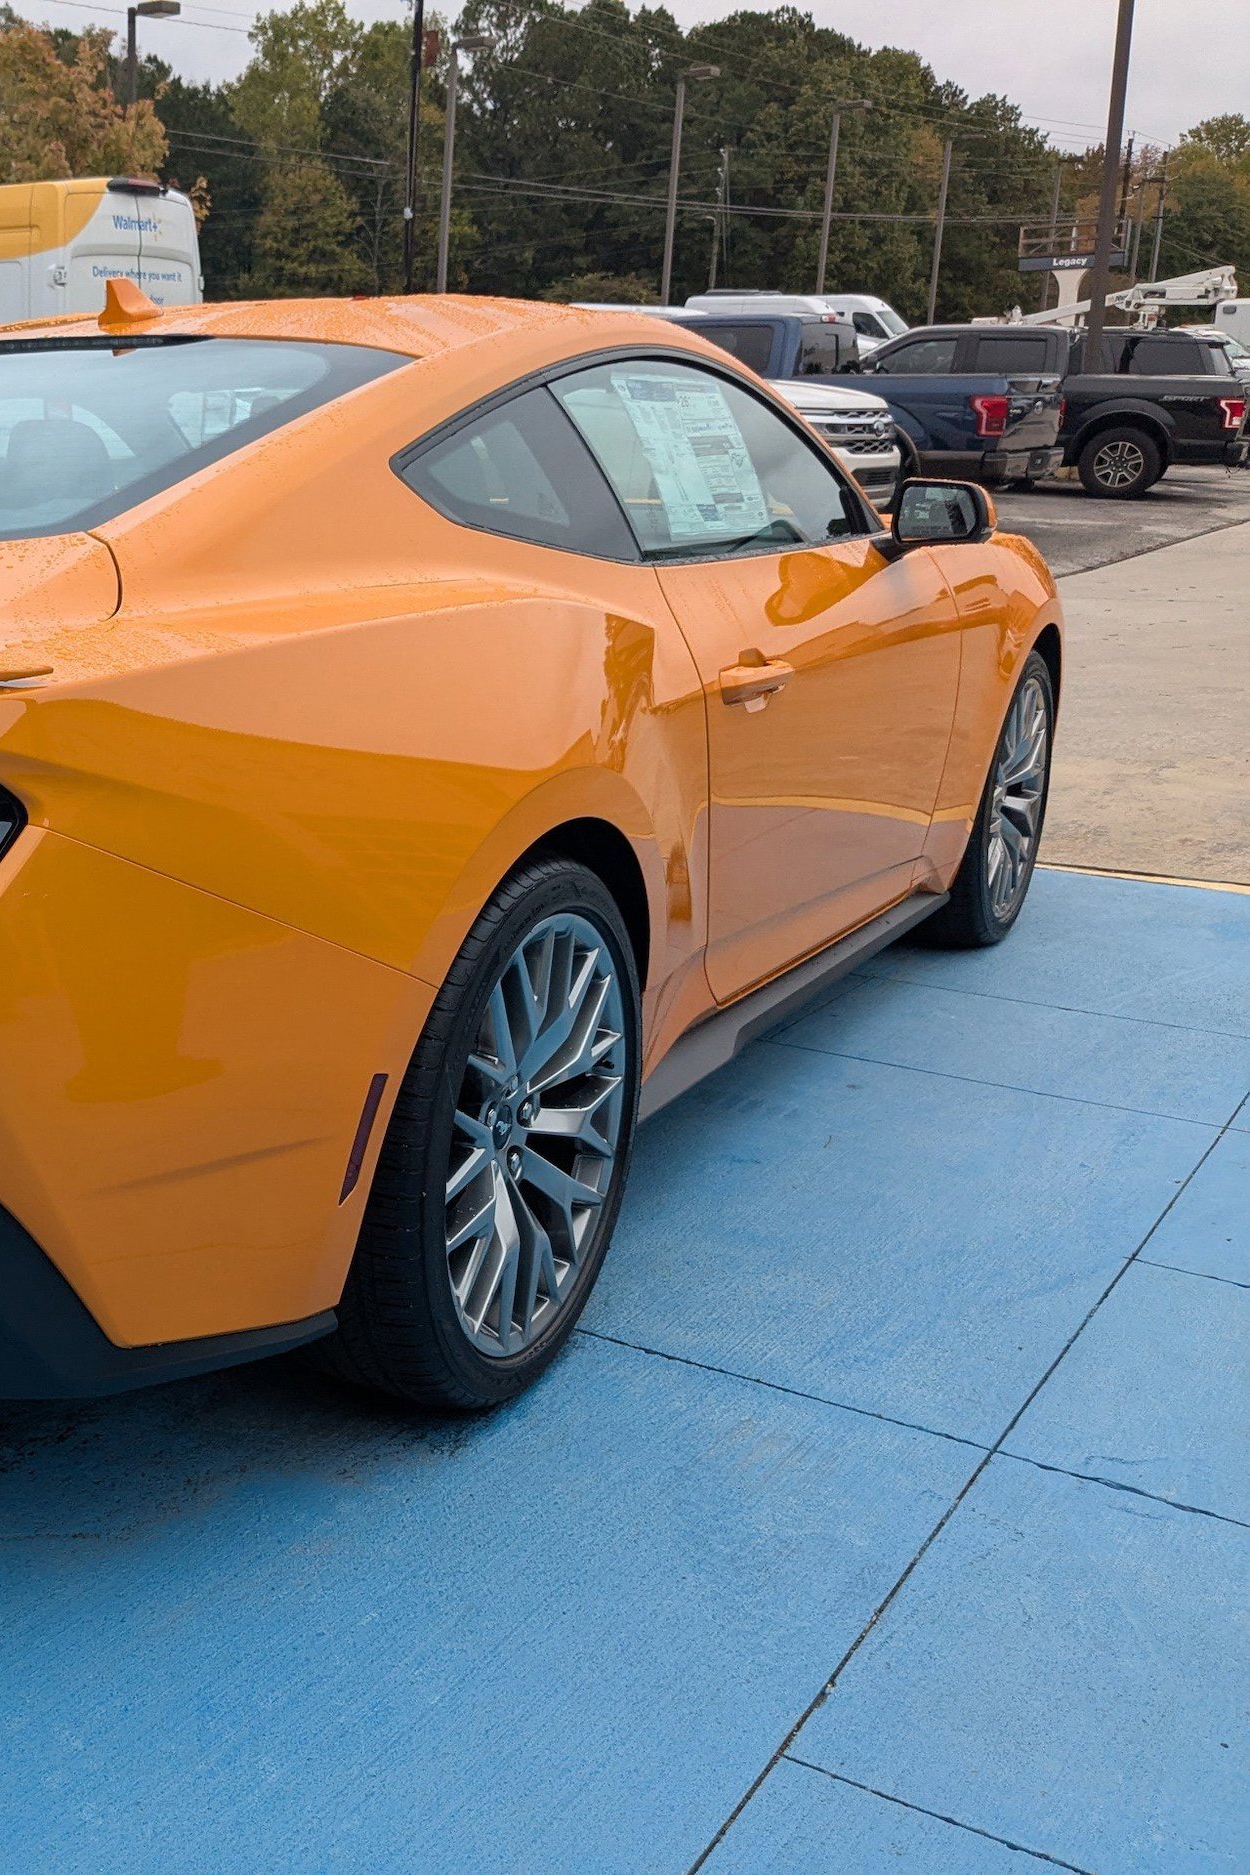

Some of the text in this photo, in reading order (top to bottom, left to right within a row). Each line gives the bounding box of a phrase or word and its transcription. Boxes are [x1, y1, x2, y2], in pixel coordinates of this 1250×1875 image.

[1052, 258, 1088, 267] Legacy
[92, 266, 182, 283] Delivery where you want it
